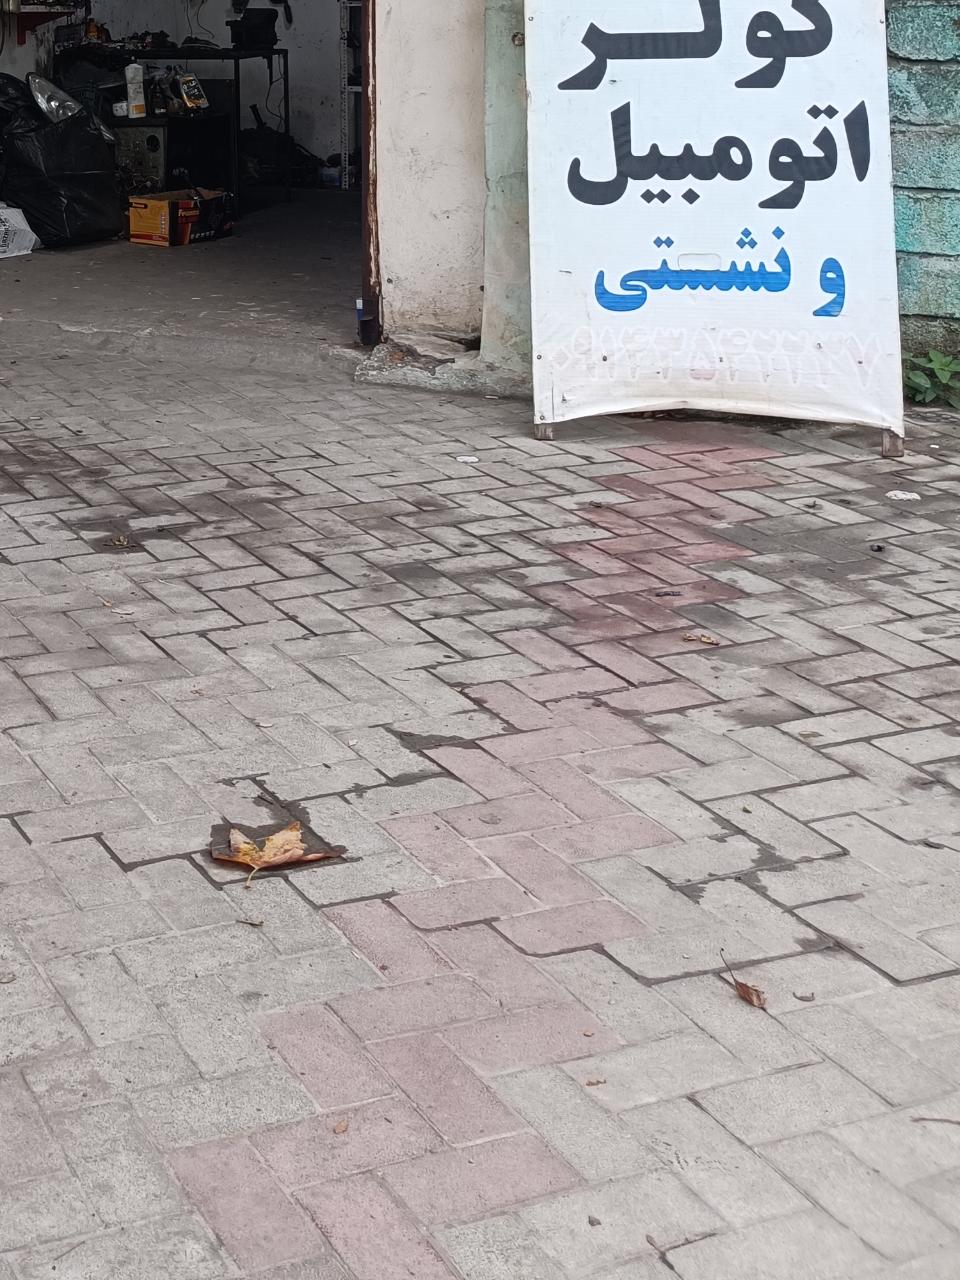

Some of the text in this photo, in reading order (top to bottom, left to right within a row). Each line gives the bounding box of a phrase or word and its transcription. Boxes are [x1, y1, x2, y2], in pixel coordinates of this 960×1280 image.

[567, 100, 871, 209] اتومبیل
[595, 226, 845, 317] و نشستی
